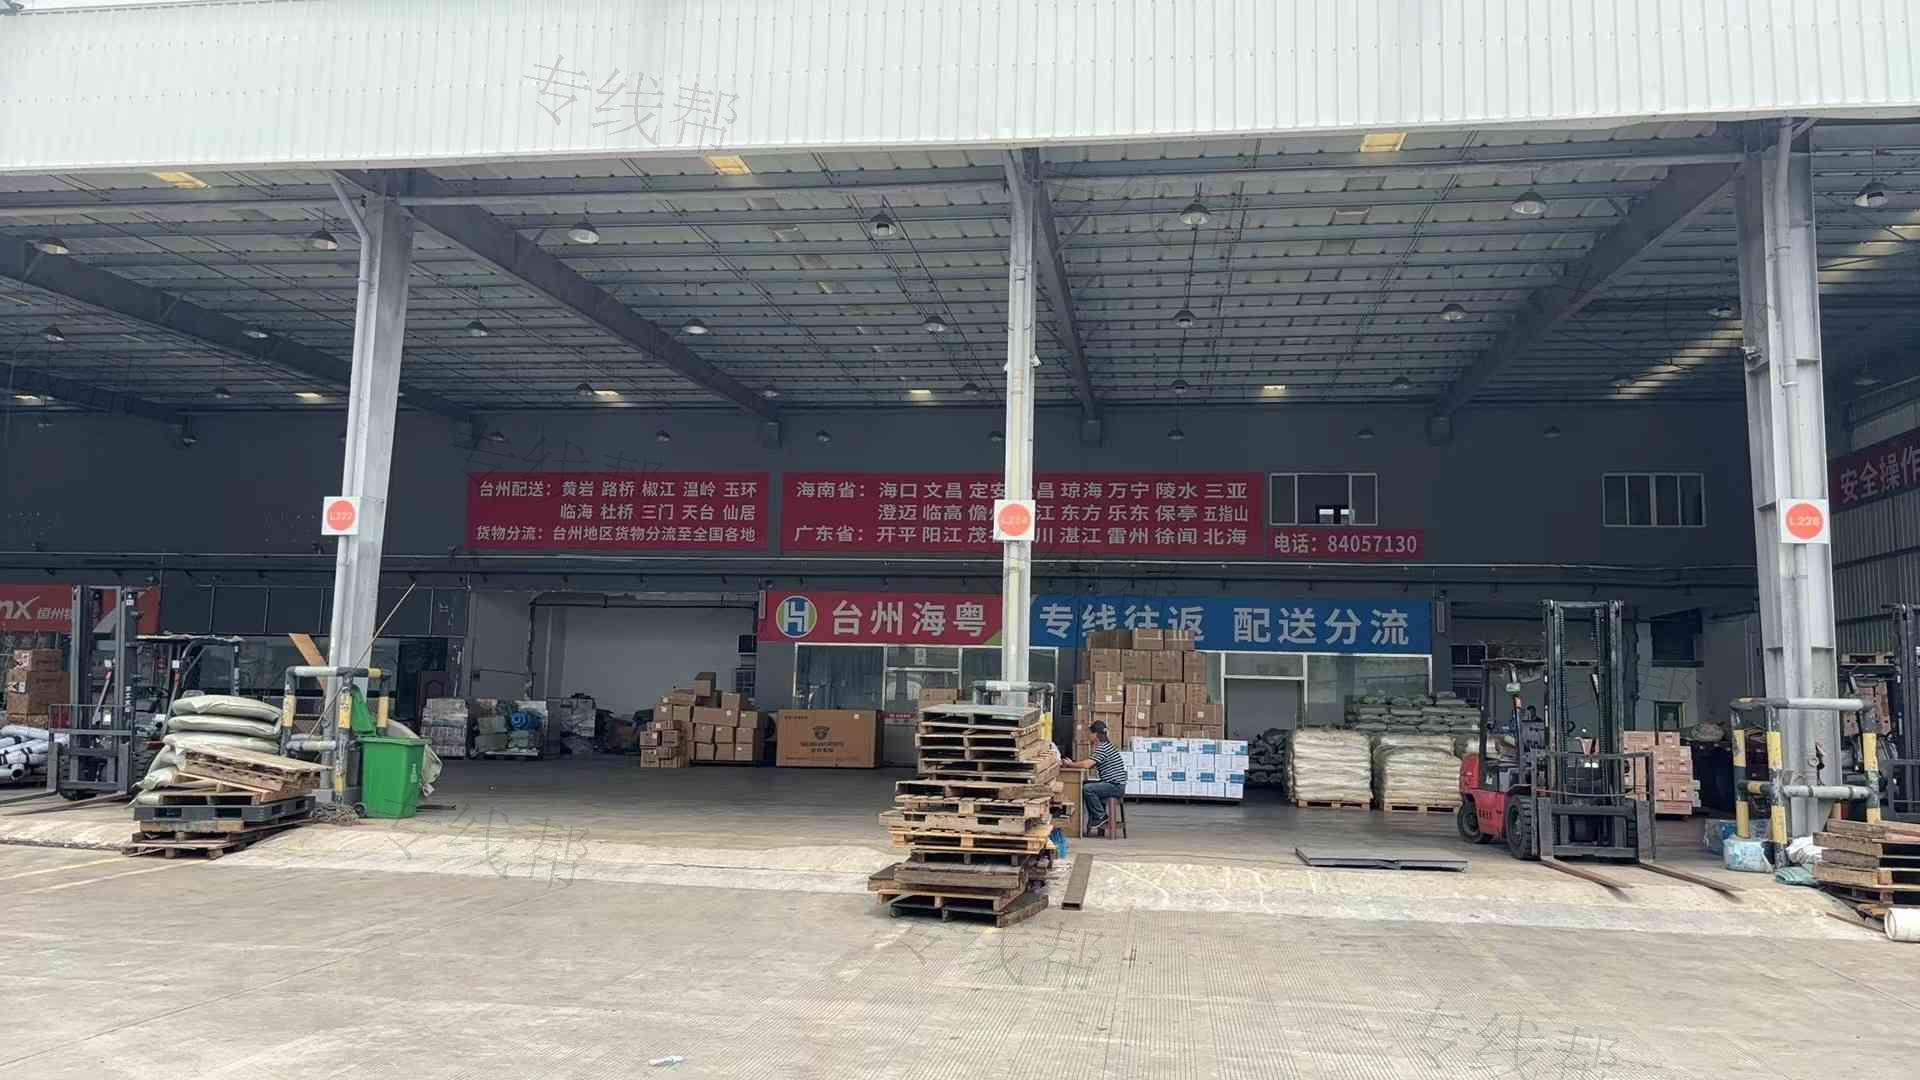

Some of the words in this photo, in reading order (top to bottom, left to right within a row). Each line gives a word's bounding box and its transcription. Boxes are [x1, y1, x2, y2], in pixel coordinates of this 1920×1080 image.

[1840, 446, 1920, 504] 安全操作
[561, 481, 594, 498] 黄岩
[601, 481, 635, 498] 路桥
[641, 481, 676, 498] 椒江
[682, 481, 716, 498] 温岭
[723, 482, 758, 498] 玉环
[879, 482, 917, 498] 海口
[923, 482, 962, 499] 文昌
[1060, 482, 1102, 499] 琼海
[1107, 482, 1150, 499] 万宁
[1155, 482, 1198, 499] 陵水
[1204, 482, 1248, 499] 三亚
[560, 504, 593, 520] 临海
[600, 504, 634, 520] 杜桥
[641, 504, 673, 520] 三门
[682, 504, 715, 520] 天台
[723, 504, 756, 521] 仙居
[877, 504, 918, 521] 澄迈
[923, 504, 962, 521] 临高
[1061, 504, 1102, 521] 东方
[1107, 504, 1149, 521] 乐东
[1155, 504, 1198, 521] 保亭
[1203, 505, 1249, 522] 五指山
[876, 526, 917, 543] 开平
[922, 526, 962, 543] 阳江
[1060, 527, 1101, 543] 湛江
[1107, 527, 1149, 544] 雷州
[1154, 527, 1197, 545] 徐闻
[1203, 527, 1247, 545] 北海
[831, 599, 987, 638] 台州海粤
[1039, 603, 1205, 641] 专线往返
[1232, 606, 1410, 646] 配送分流
